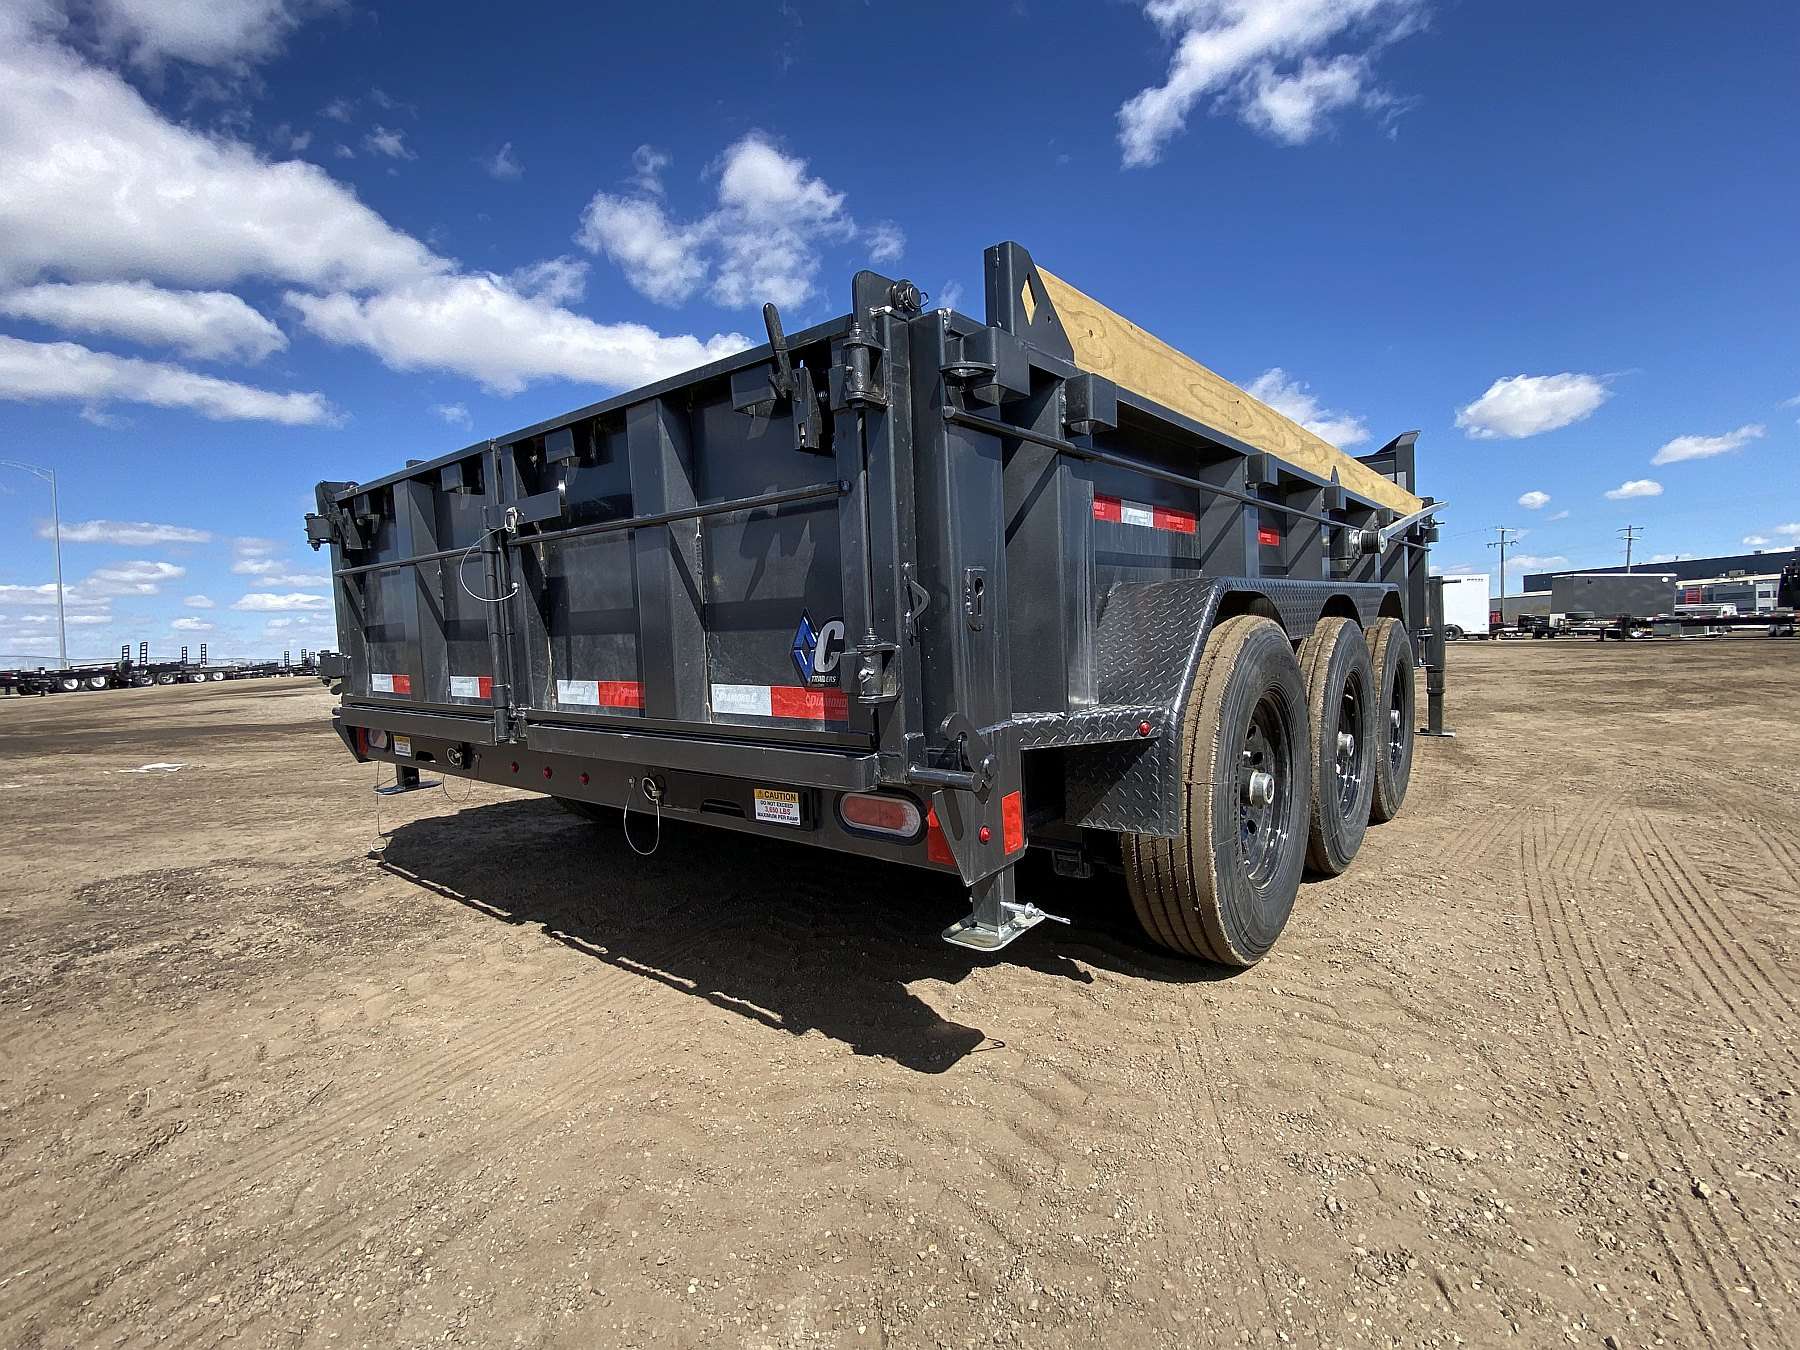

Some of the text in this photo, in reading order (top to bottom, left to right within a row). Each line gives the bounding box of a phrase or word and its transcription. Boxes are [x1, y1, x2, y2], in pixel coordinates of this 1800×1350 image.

[814, 621, 845, 672] C
[811, 675, 837, 683] TRAILERS
[764, 791, 796, 801] CAUTION
[779, 807, 790, 815] LBS
